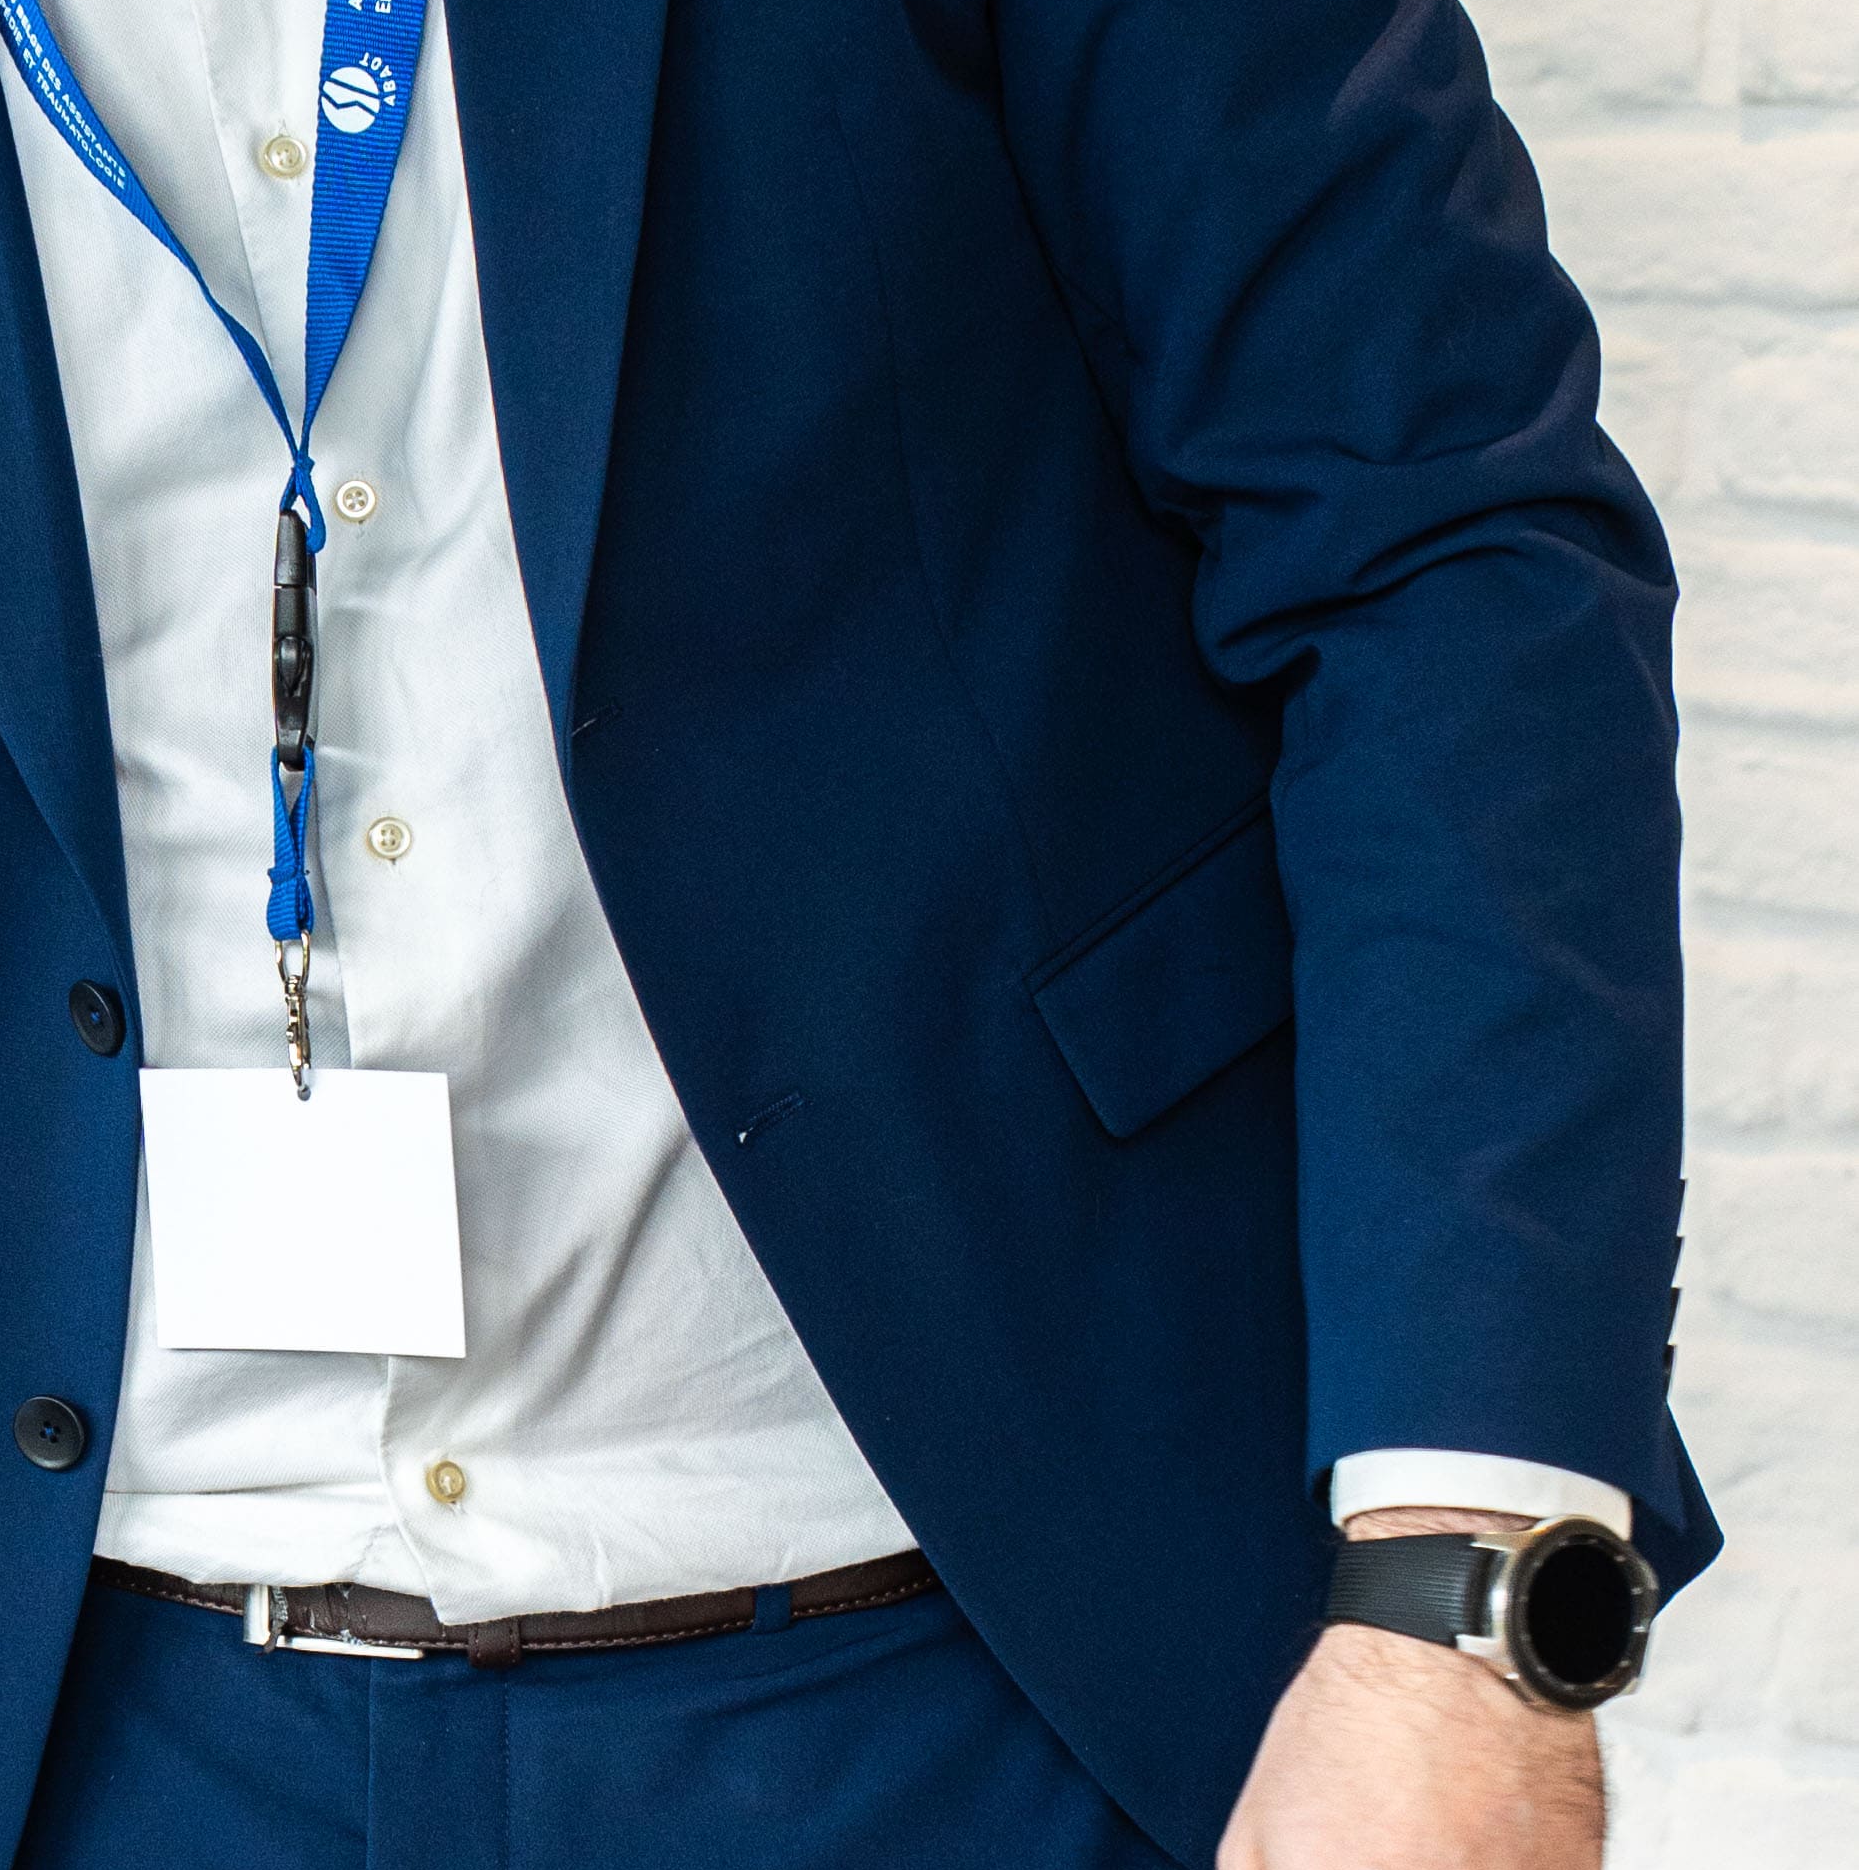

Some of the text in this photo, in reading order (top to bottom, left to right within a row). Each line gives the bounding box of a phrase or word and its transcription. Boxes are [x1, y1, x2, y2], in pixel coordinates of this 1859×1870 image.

[15, 4, 43, 58] BELGE
[42, 56, 62, 91] DES
[61, 93, 127, 178] ASSISTANTS
[22, 48, 37, 69] ET
[36, 70, 126, 190] TRAUMATOLOGIE
[358, 52, 396, 107] ABAOT
